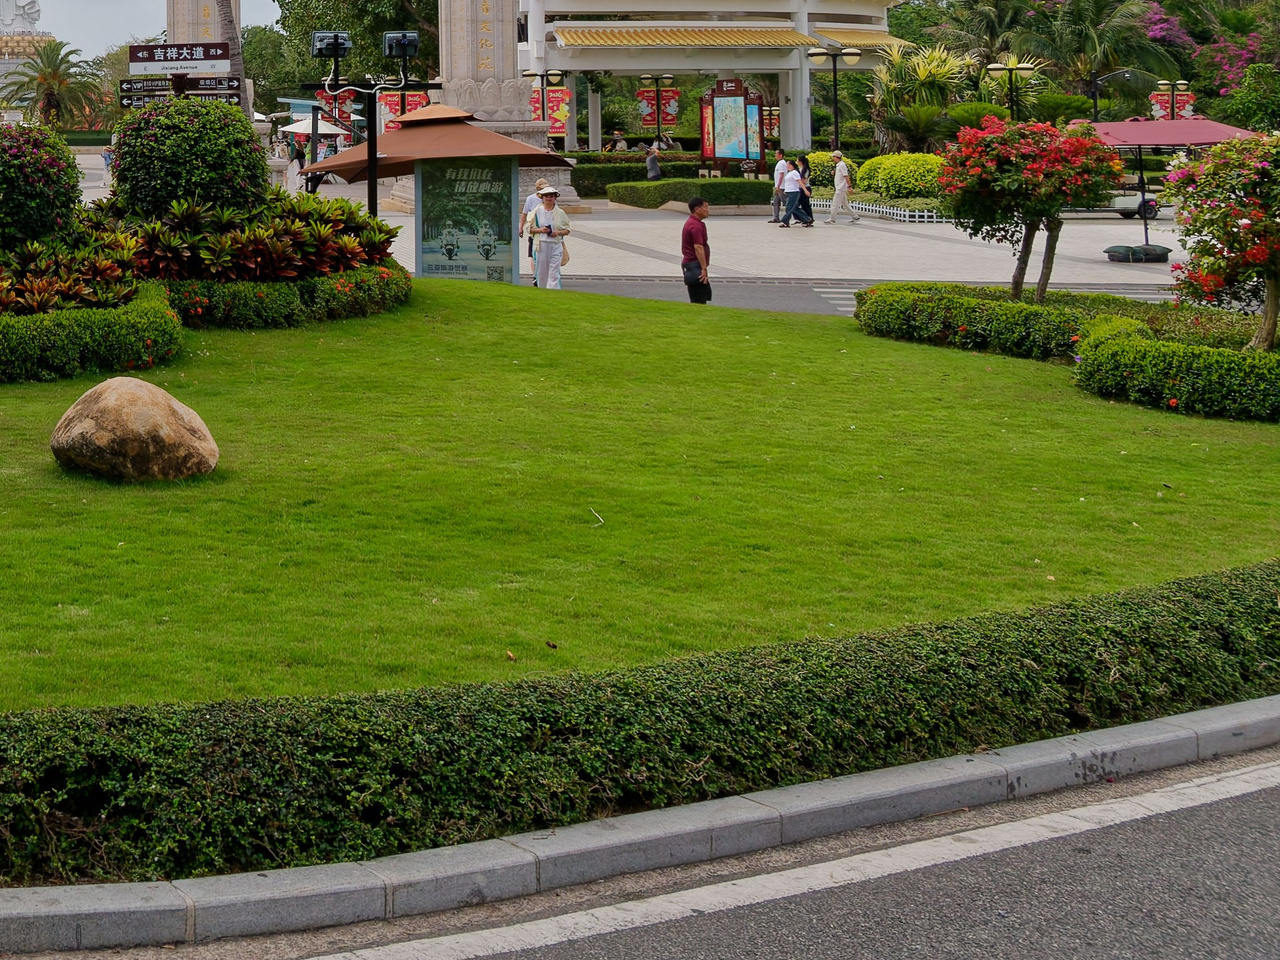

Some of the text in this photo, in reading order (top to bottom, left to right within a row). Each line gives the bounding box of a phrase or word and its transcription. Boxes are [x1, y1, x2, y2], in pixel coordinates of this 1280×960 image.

[153, 46, 205, 60] 吉祥大道
[209, 48, 216, 56] 西
[445, 168, 493, 180] 有我们在
[454, 181, 503, 193] 请放心游
